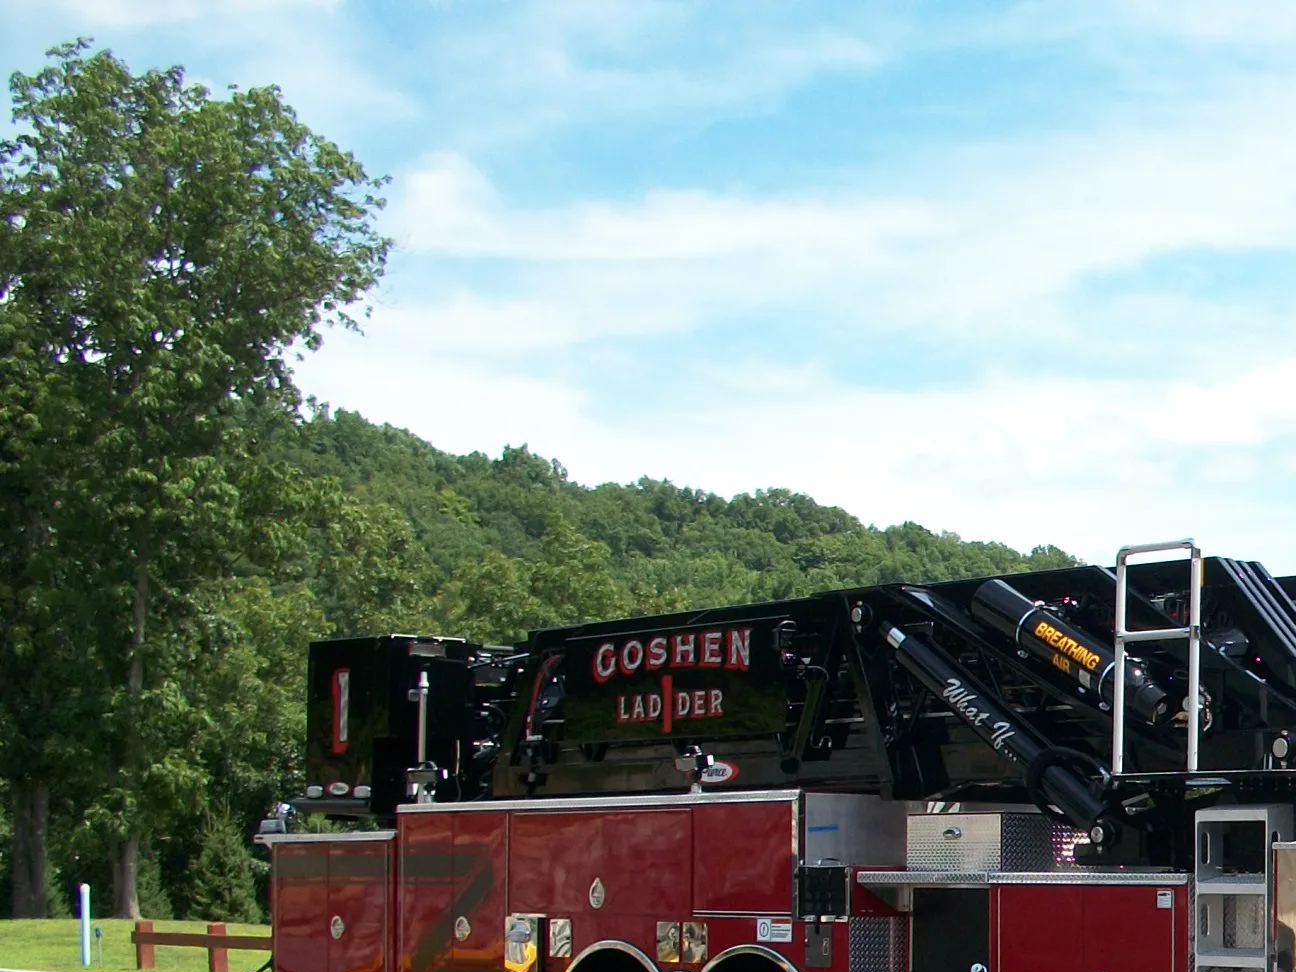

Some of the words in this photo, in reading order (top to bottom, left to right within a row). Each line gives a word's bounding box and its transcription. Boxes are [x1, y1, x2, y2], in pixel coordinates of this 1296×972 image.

[593, 628, 751, 682] GOSHEN
[1034, 621, 1100, 671] BREATHING
[1052, 653, 1070, 674] AIR
[331, 668, 350, 754] 1
[942, 678, 990, 726] What
